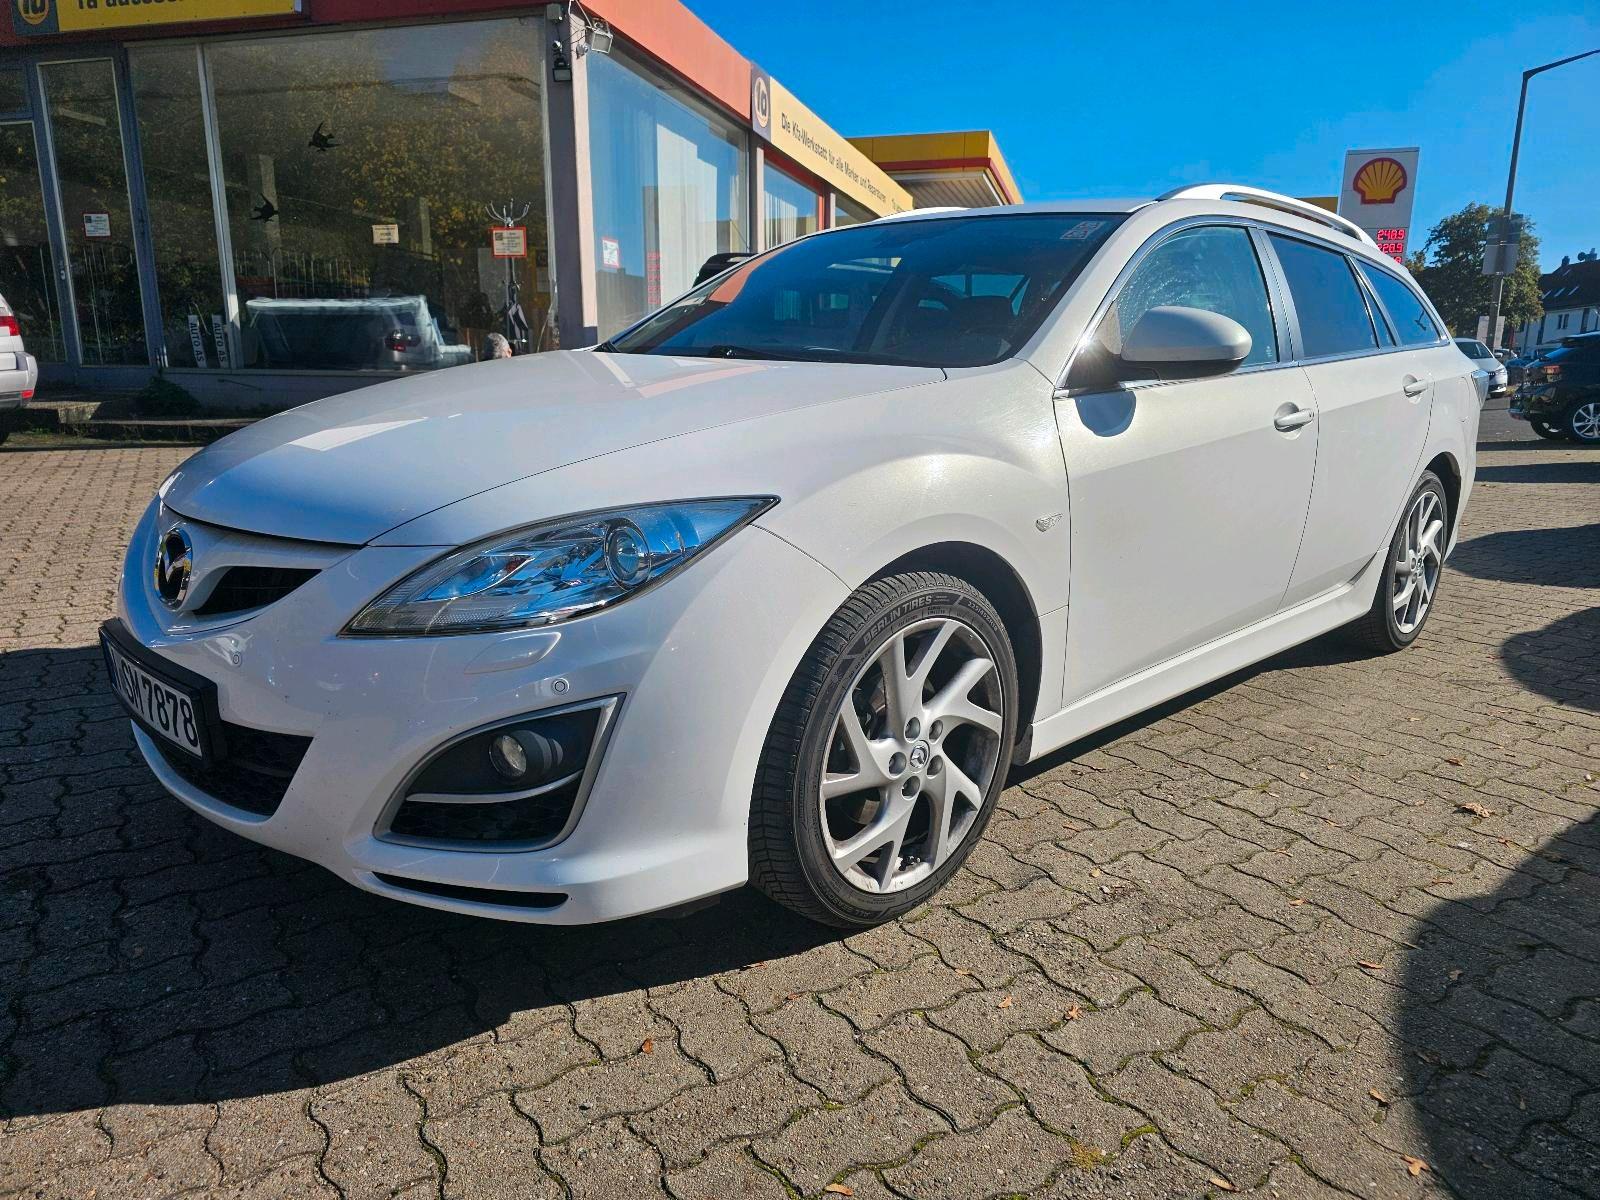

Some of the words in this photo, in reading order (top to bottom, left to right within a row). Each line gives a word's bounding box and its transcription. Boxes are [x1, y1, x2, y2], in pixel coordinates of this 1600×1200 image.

[781, 112, 791, 134] Die
[792, 120, 828, 161] Kfz-Werkstatt
[190, 322, 201, 347] AUTO
[213, 322, 224, 347] AUTO
[863, 607, 902, 646] BERLIN
[902, 595, 933, 615] TIRES
[142, 674, 198, 748] 7878
